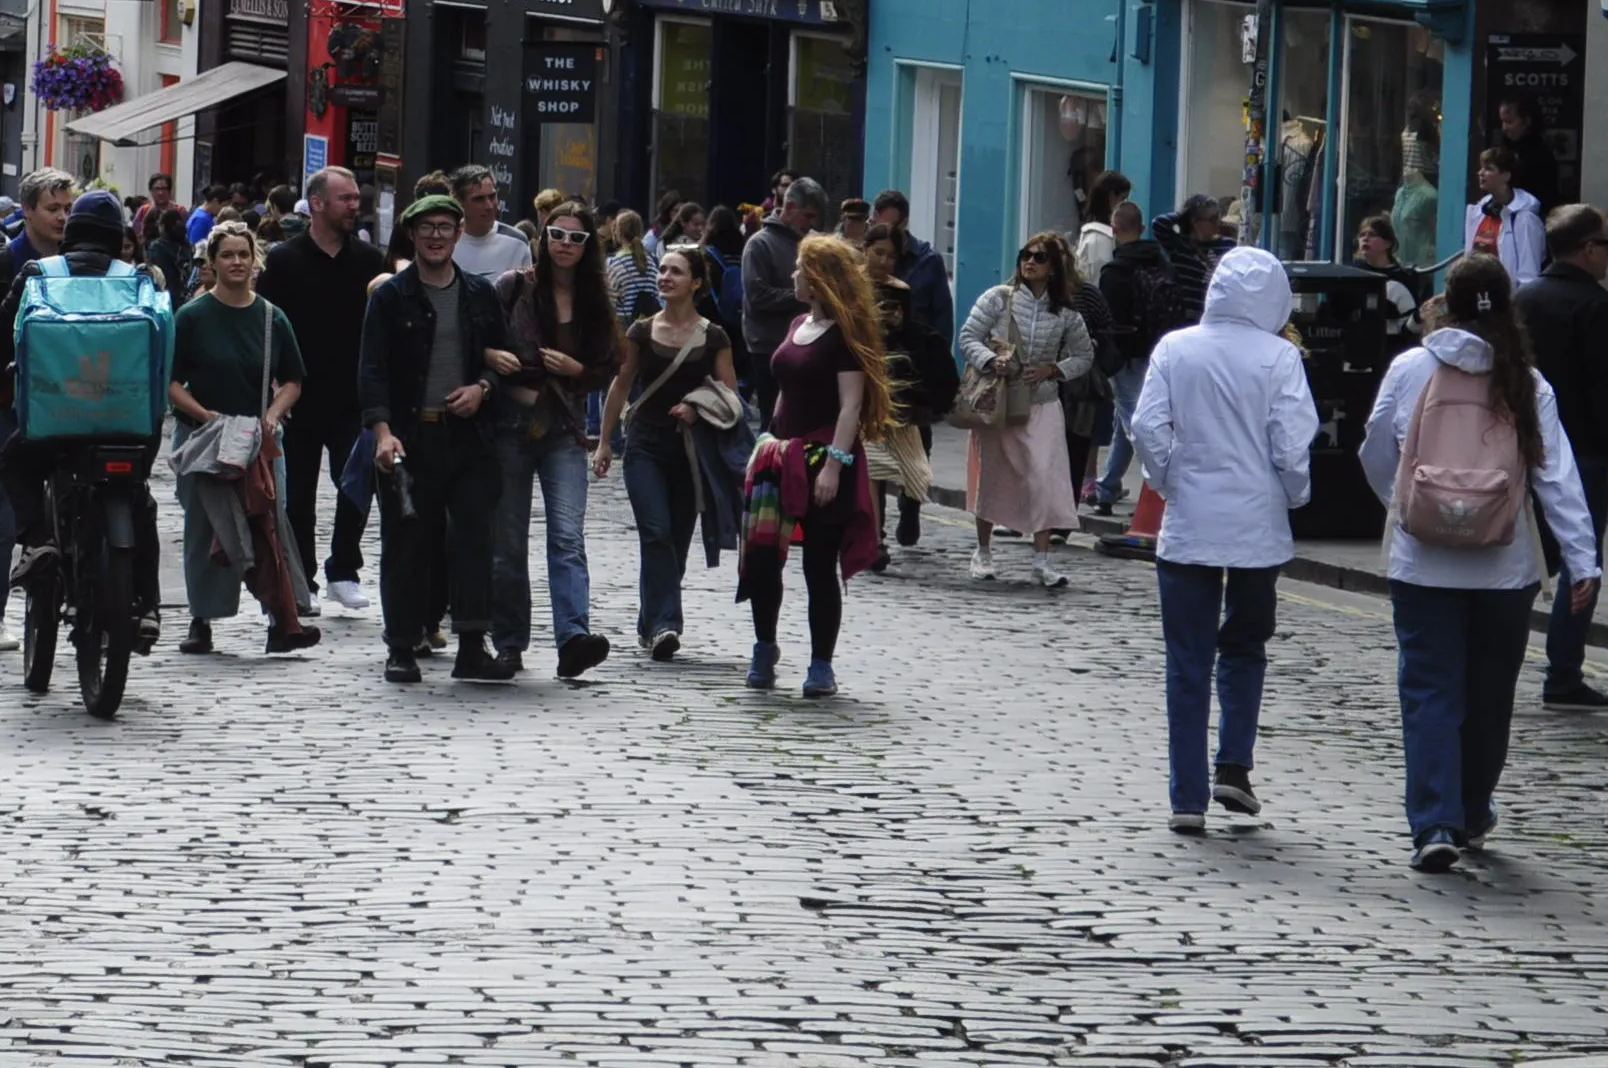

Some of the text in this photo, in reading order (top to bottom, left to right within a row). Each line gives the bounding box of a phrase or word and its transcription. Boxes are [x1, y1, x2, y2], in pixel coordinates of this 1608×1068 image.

[544, 56, 575, 69] THE
[529, 79, 591, 92] WHISKY
[1504, 72, 1569, 86] SCOTTS
[537, 100, 580, 113] SHOP
[1308, 326, 1344, 338] Litter
